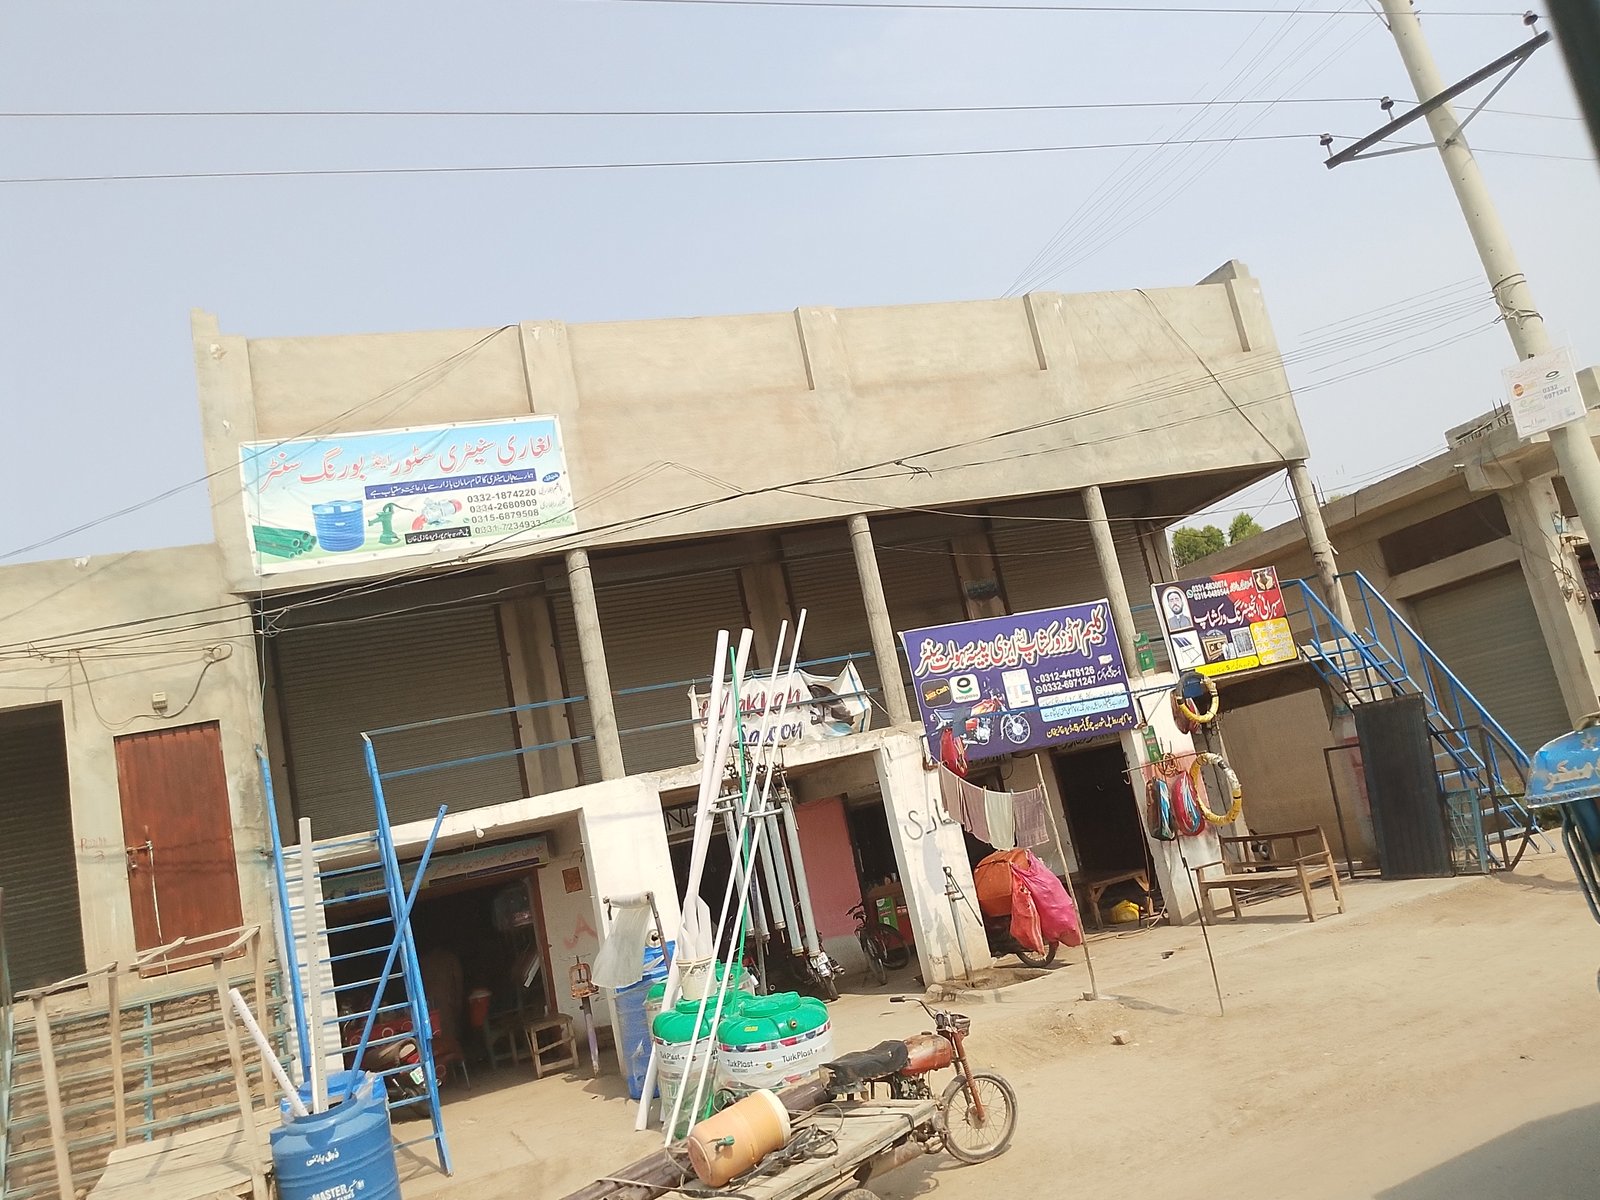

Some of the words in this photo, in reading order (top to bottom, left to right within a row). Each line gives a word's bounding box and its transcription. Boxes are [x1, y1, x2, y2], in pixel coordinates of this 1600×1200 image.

[391, 442, 435, 475] سٹور
[497, 434, 553, 466] لغاری
[259, 452, 303, 493] سنٹر
[300, 446, 367, 485] بورنگ
[467, 489, 536, 503] 0332-1874220
[470, 499, 537, 513] 0334-2680909
[472, 509, 539, 523] 0315-6879508
[1193, 603, 1226, 630] ورکشاپ
[1081, 605, 1106, 656] کلیم
[1040, 666, 1095, 683] 0312-4478126
[1043, 675, 1096, 692] 0332-6971247
[781, 1049, 814, 1063] TurkPlast
[311, 1183, 348, 1200] MASTER
